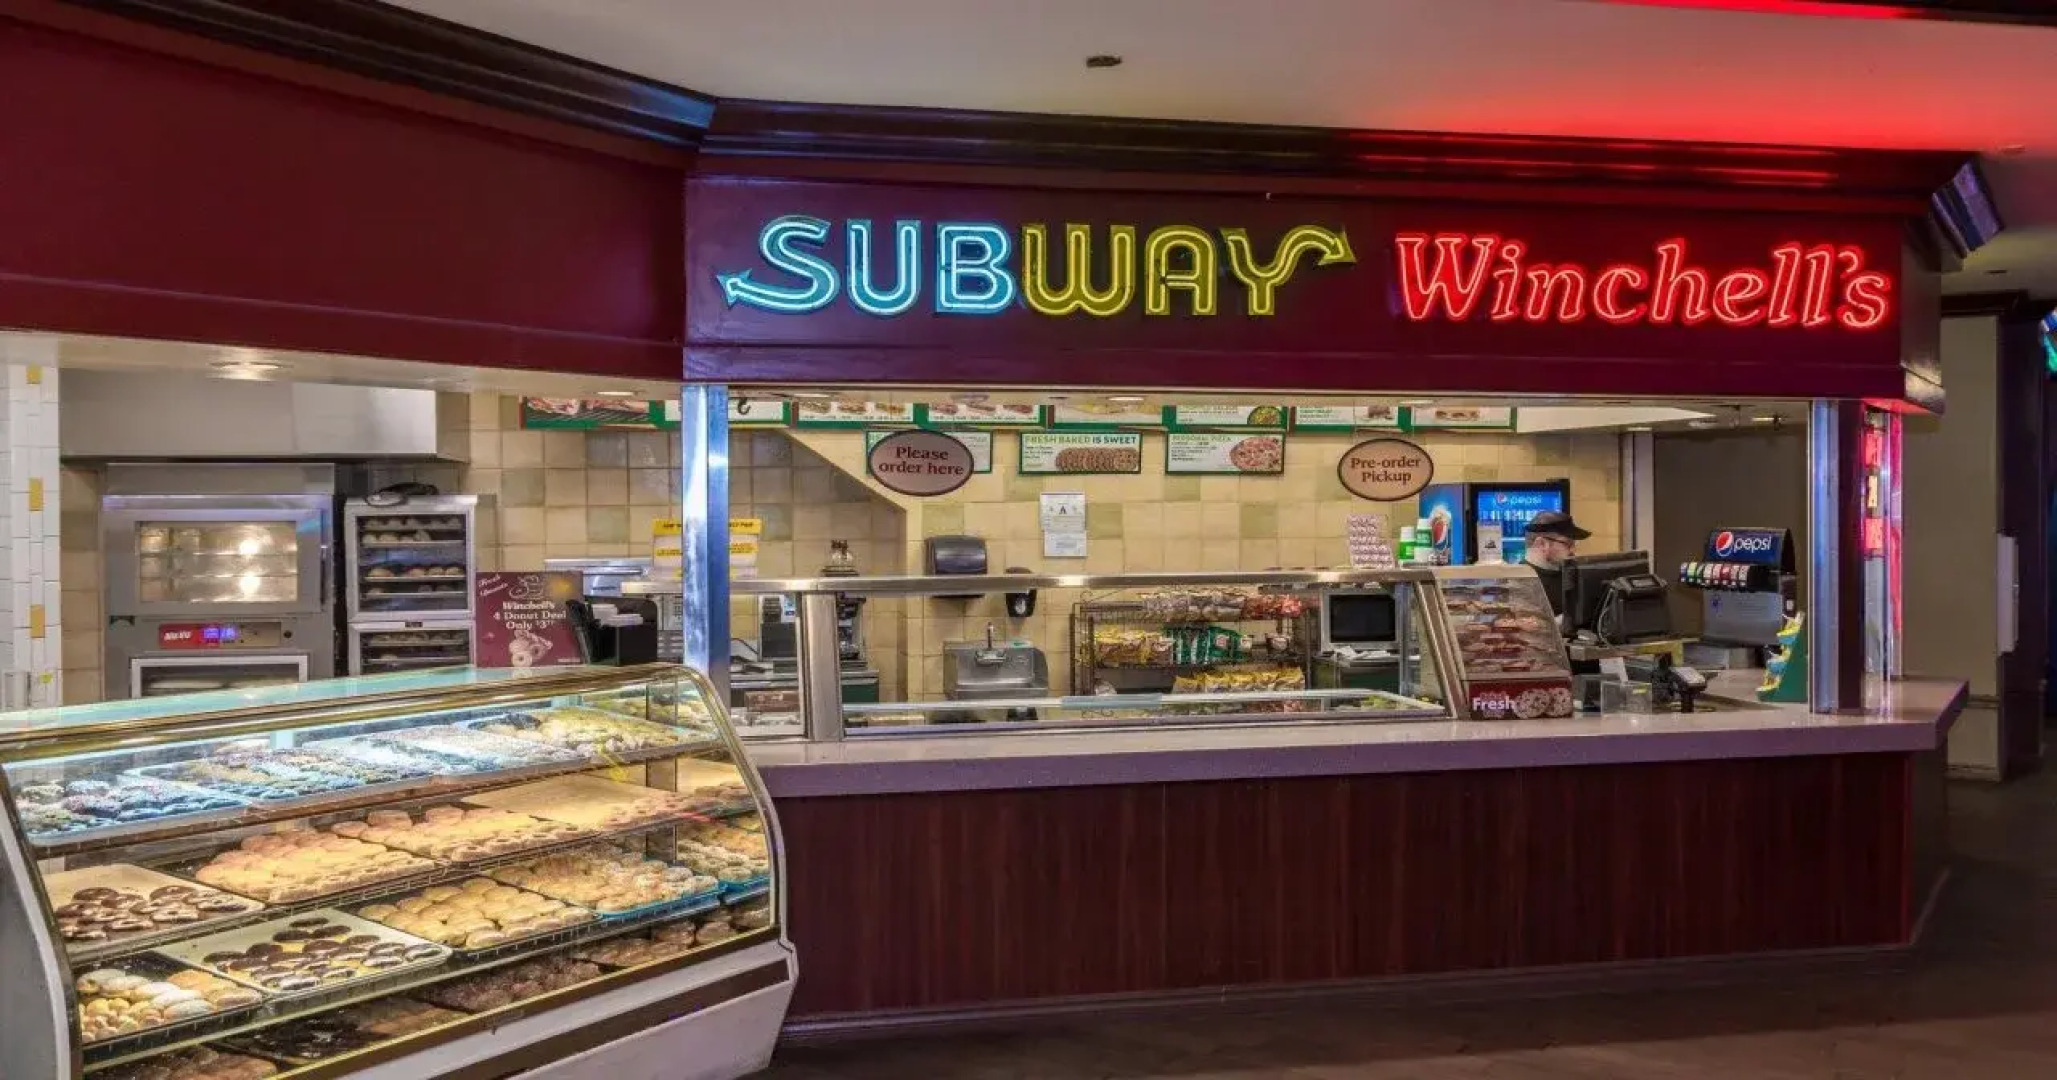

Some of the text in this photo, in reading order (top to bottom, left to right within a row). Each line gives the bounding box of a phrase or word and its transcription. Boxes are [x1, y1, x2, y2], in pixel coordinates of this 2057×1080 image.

[716, 214, 1356, 316] SUBWAY
[1394, 232, 1892, 330] Winchell's
[1025, 435, 1136, 445] FRESH BAKED IS SWEET
[896, 446, 949, 460] Please
[878, 461, 964, 475] order here
[1350, 457, 1421, 469] Pre-order
[1362, 470, 1412, 485] Pickup
[1733, 535, 1772, 553] pepsi
[502, 601, 556, 611] Winchell's
[493, 610, 567, 620] 4 Donut Deal
[505, 620, 532, 630] Only
[1472, 695, 1516, 711] Fresh
